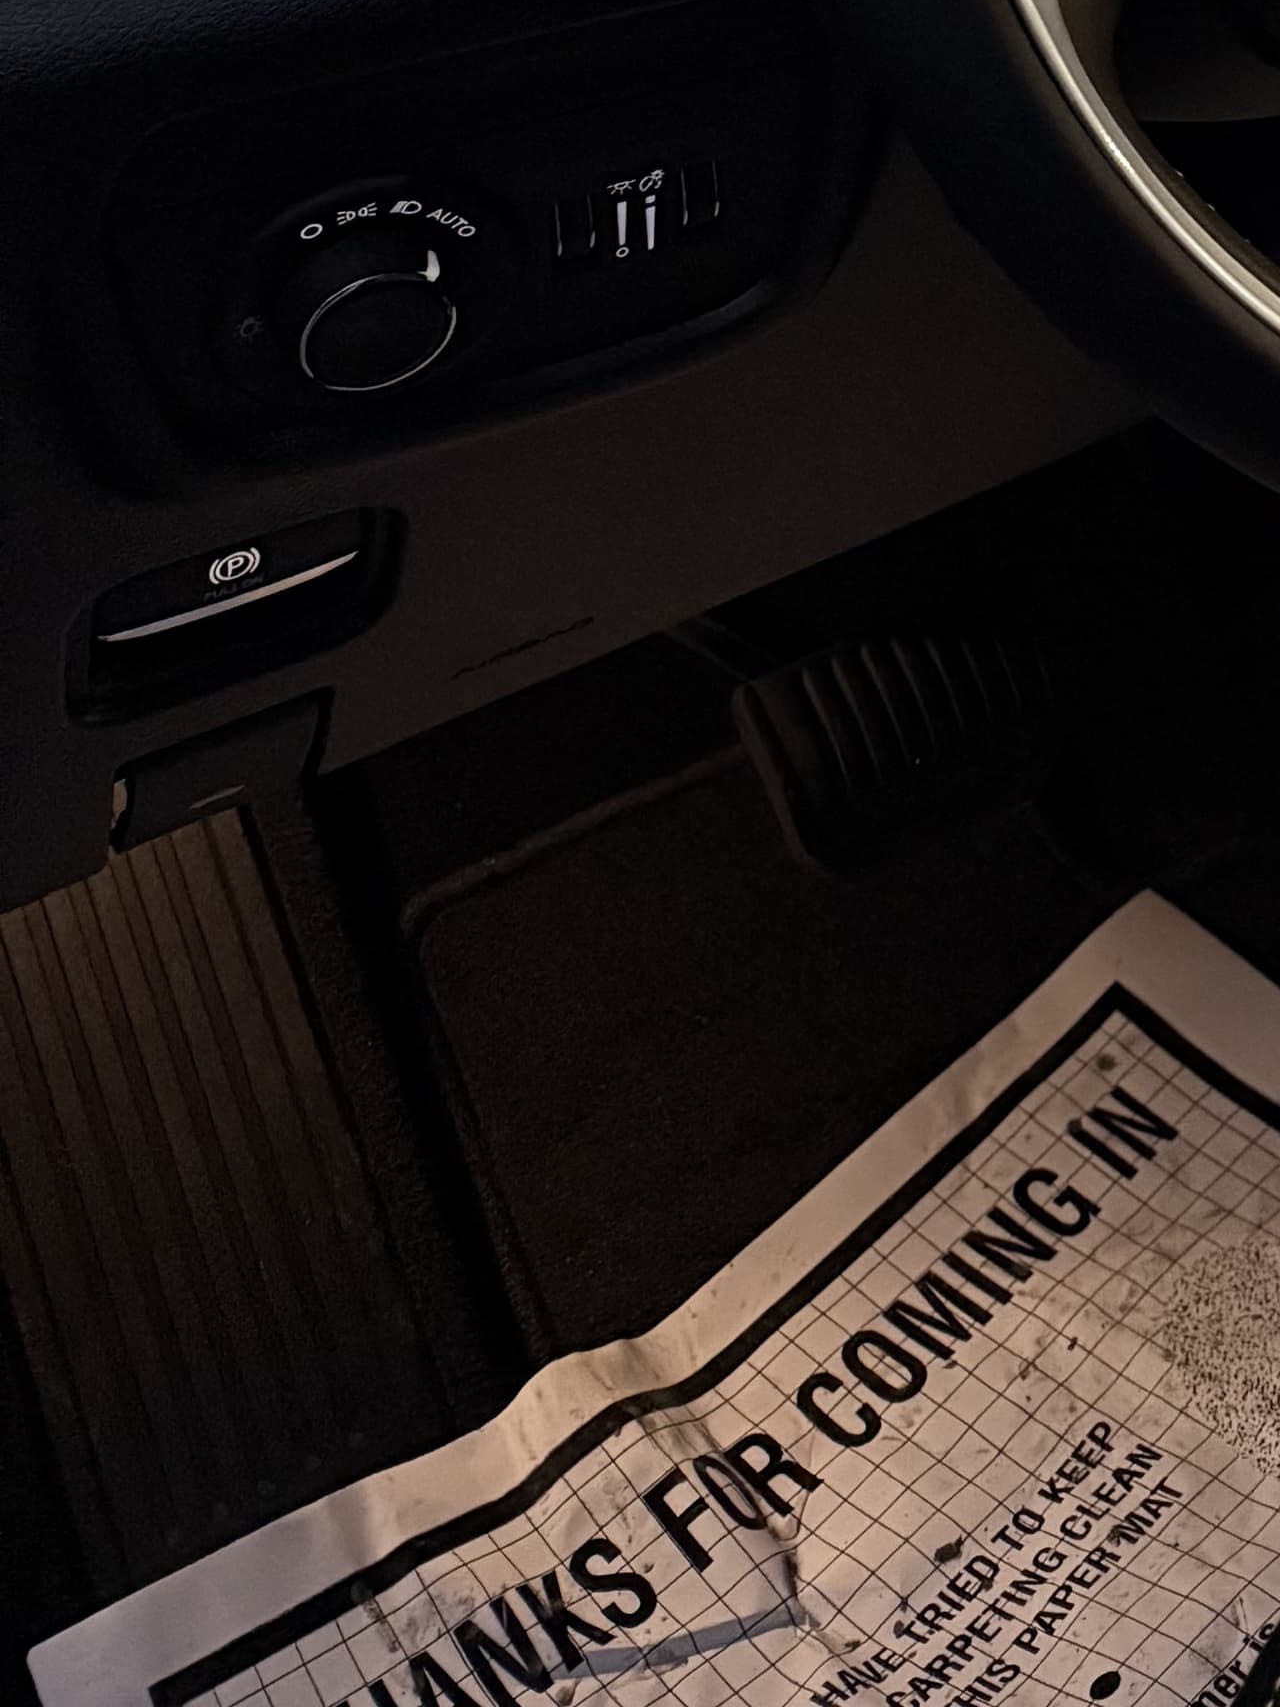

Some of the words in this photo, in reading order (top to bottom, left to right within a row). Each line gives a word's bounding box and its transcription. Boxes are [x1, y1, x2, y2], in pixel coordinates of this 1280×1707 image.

[426, 207, 477, 238] AUTO
[335, 1537, 658, 1707] ANKS
[643, 1430, 827, 1577] FOR
[793, 1167, 1103, 1450] COMING
[1073, 1082, 1187, 1184] IN
[810, 1646, 905, 1707] HAVE
[901, 1553, 999, 1646] TRIED
[992, 1505, 1045, 1553] TO
[1040, 1420, 1120, 1505] KEEP
[886, 1546, 1067, 1707] CARPETING
[1059, 1442, 1166, 1542] CLEAN
[945, 1659, 1021, 1707] HIS
[1013, 1544, 1120, 1656] PAPER
[1120, 1476, 1184, 1547] MAT
